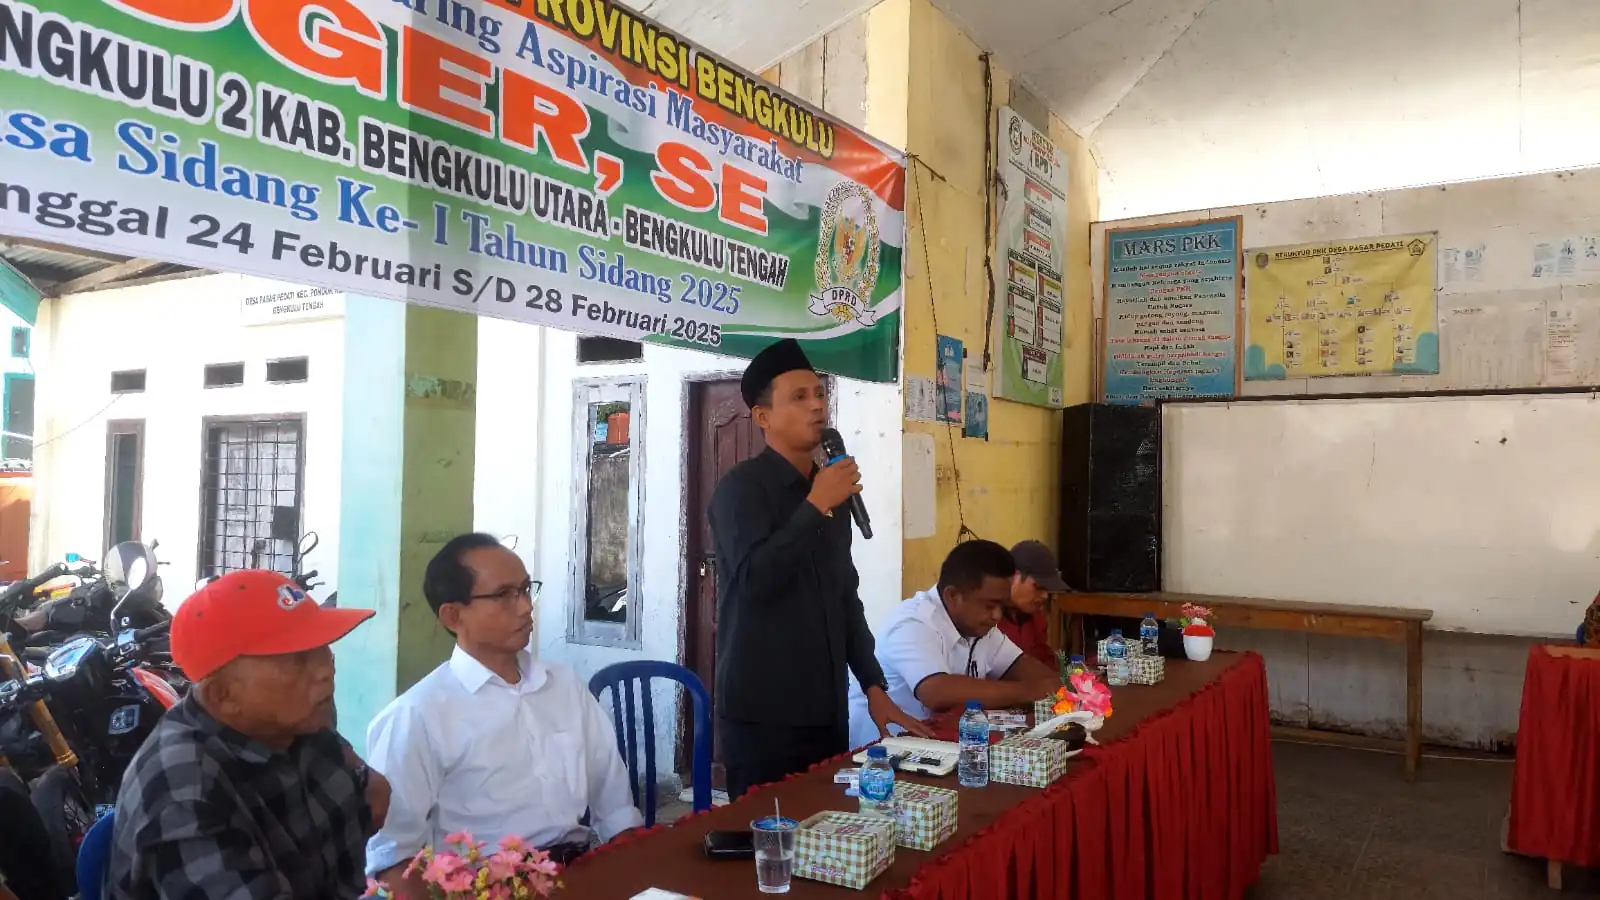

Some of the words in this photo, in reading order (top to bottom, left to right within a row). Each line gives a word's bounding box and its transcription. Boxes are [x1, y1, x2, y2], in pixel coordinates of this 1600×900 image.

[117, 0, 621, 192] GER,
[654, 143, 767, 232] SE
[516, 22, 657, 119] Aspirasi
[667, 88, 802, 183] Masyarakat
[697, 56, 833, 156] BENGKULU
[0, 112, 92, 162] sa
[118, 121, 320, 221] Sidang
[337, 177, 418, 232] Ke-
[462, 211, 568, 274] Tahun
[579, 245, 673, 304] Sidang
[680, 274, 741, 315] 2025
[222, 78, 248, 130] 2
[262, 89, 352, 161] KAB.
[363, 123, 525, 211] BENGKULU
[534, 177, 608, 237] UTARA
[626, 208, 724, 269] BENGKULU
[728, 241, 788, 288] TENGAH
[186, 214, 254, 255] 24
[271, 230, 441, 291] Februari
[452, 268, 516, 304] S/D
[525, 284, 563, 314] 28
[571, 294, 668, 334] Februari
[671, 316, 722, 345] 2025
[832, 289, 857, 307] DPRD
[1123, 238, 1176, 257] MARS
[1181, 234, 1222, 251] PKK
[1349, 243, 1375, 252] PASAR
[1376, 240, 1404, 249] PEDATI
[302, 300, 324, 312] TENGAH
